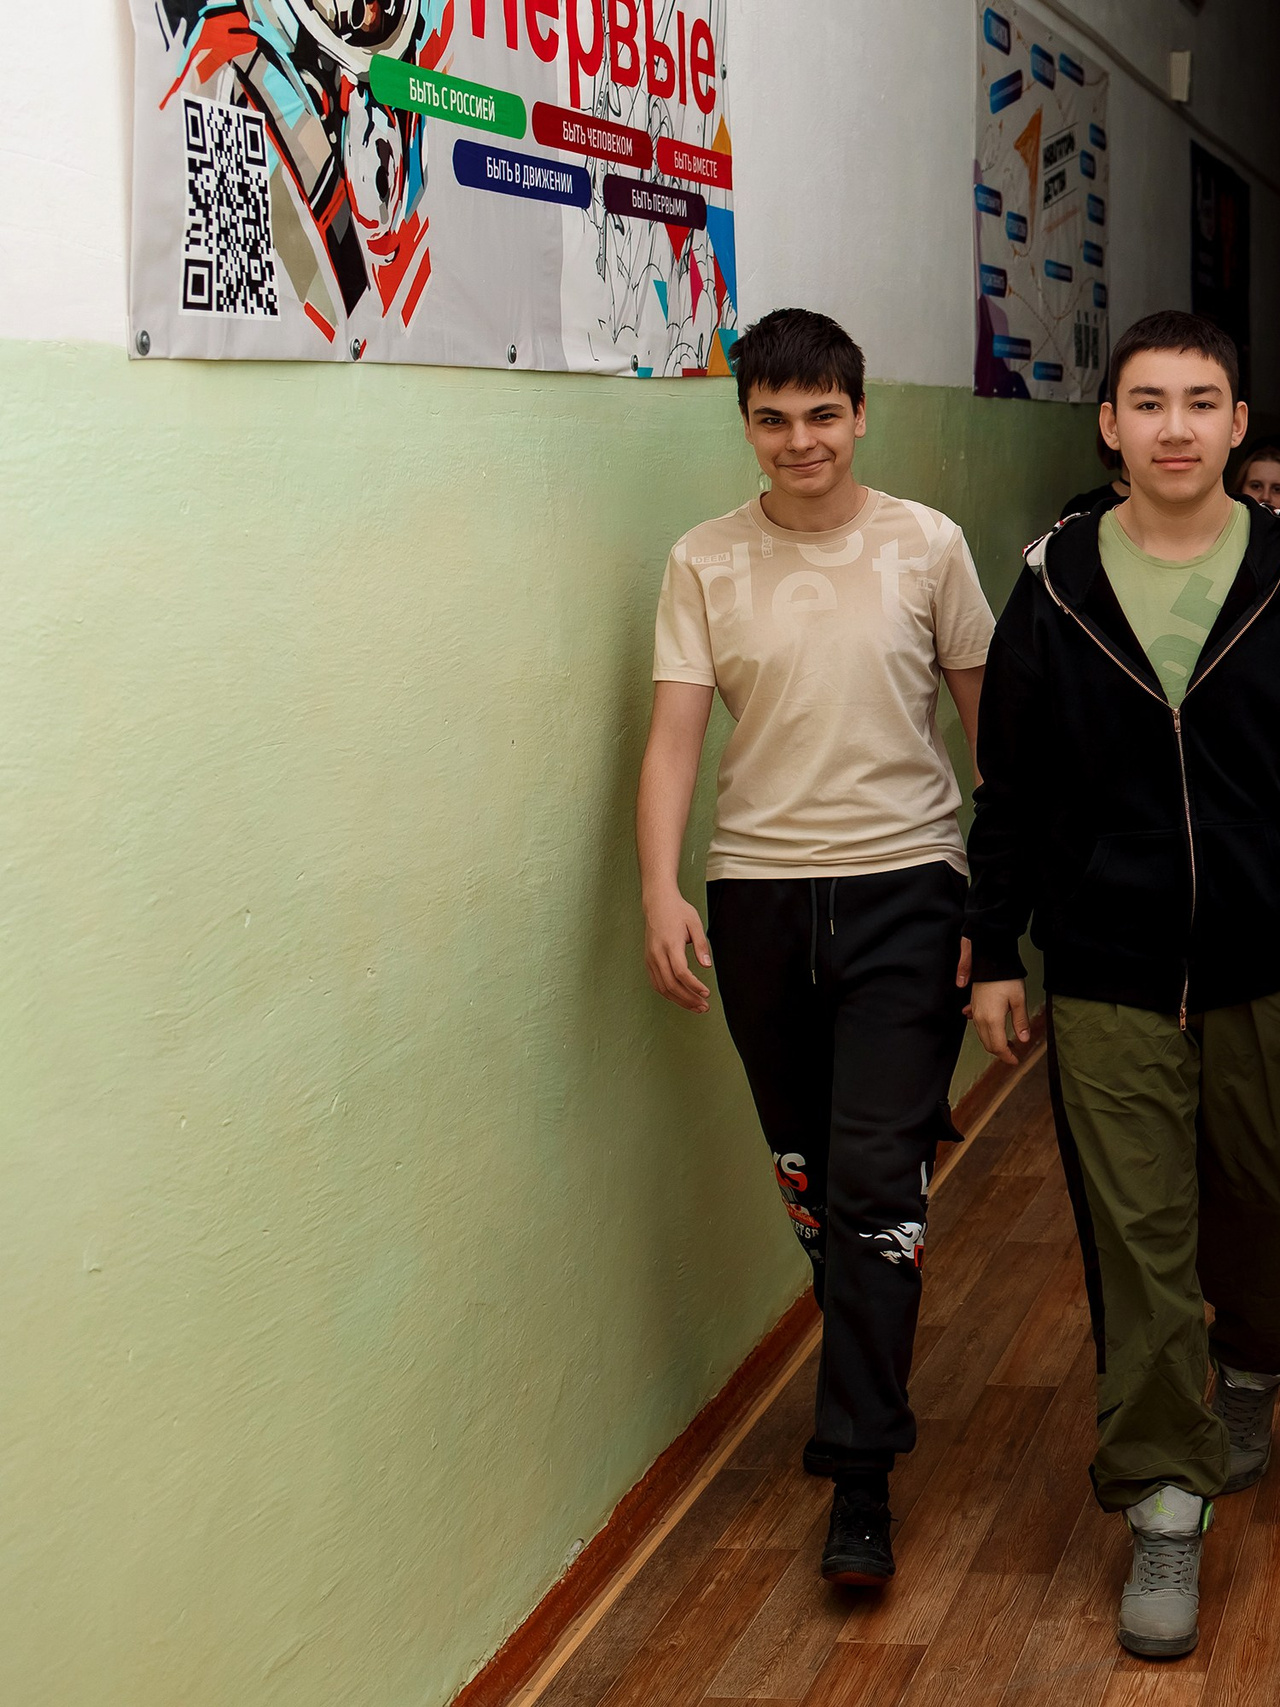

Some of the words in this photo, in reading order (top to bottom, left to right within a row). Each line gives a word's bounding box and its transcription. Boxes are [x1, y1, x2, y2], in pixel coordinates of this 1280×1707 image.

[409, 77, 440, 107] БЫТЬ
[441, 87, 448, 110] С
[450, 89, 496, 122] РОССИЕЙ
[562, 120, 587, 145] БЫТЬ
[587, 127, 633, 157] ЧЕЛОВЕКОМ
[486, 156, 514, 183] БЫТЬ
[514, 162, 521, 184] В
[522, 164, 573, 195] ДВИЖЕНИИ
[673, 150, 692, 173] БЫТЬ
[692, 155, 718, 179] ВМЕСТЕ
[631, 188, 652, 211] БЫТЬ
[652, 193, 688, 218] ПЕРВЫМИ
[695, 553, 727, 564] DEEM
